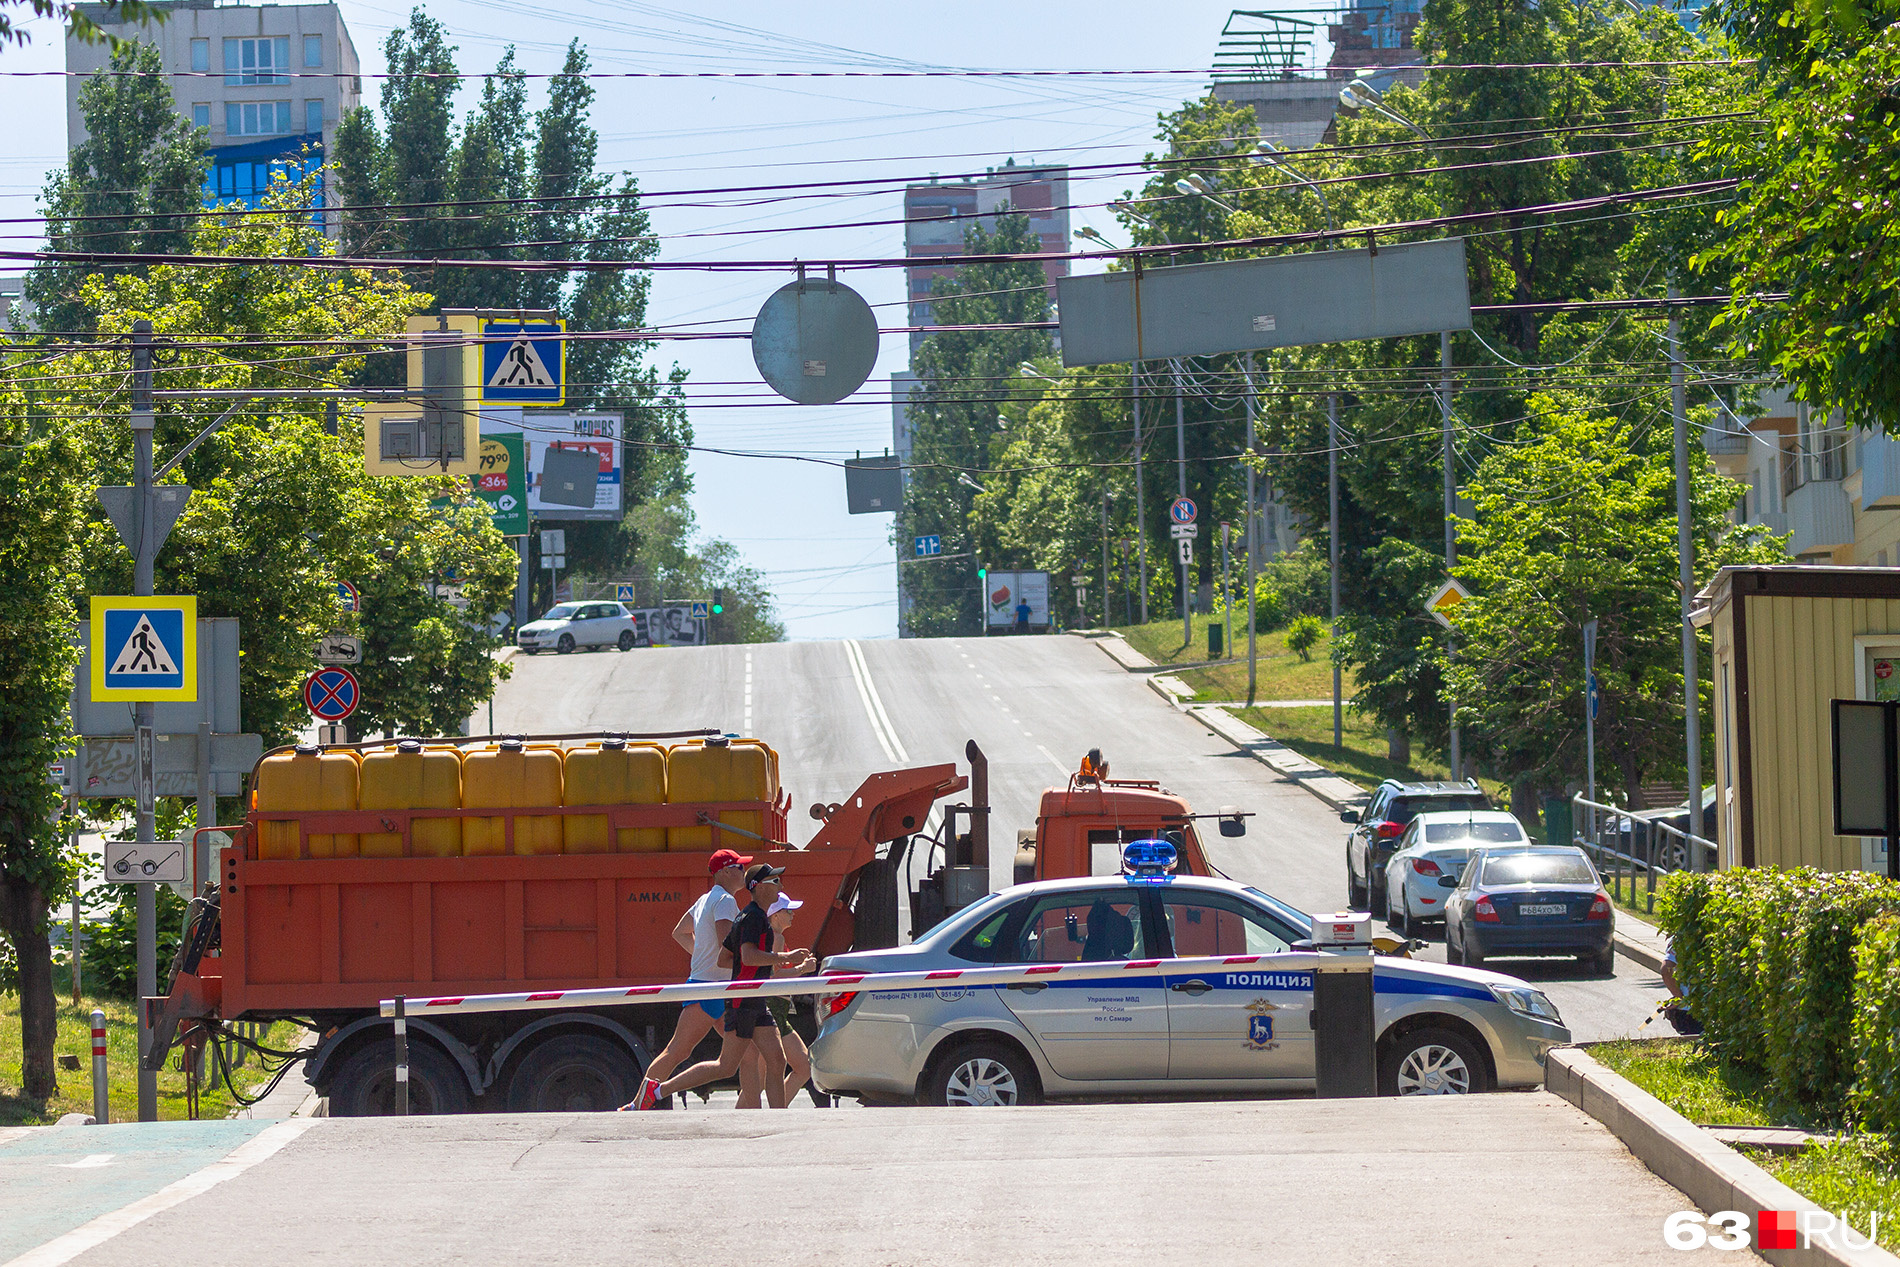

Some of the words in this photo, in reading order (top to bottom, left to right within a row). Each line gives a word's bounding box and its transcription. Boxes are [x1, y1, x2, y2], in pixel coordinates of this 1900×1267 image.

[480, 476, 507, 487] -36%
[1226, 974, 1311, 988] ПОЛИЦИЯ
[919, 992, 934, 1000] (846)
